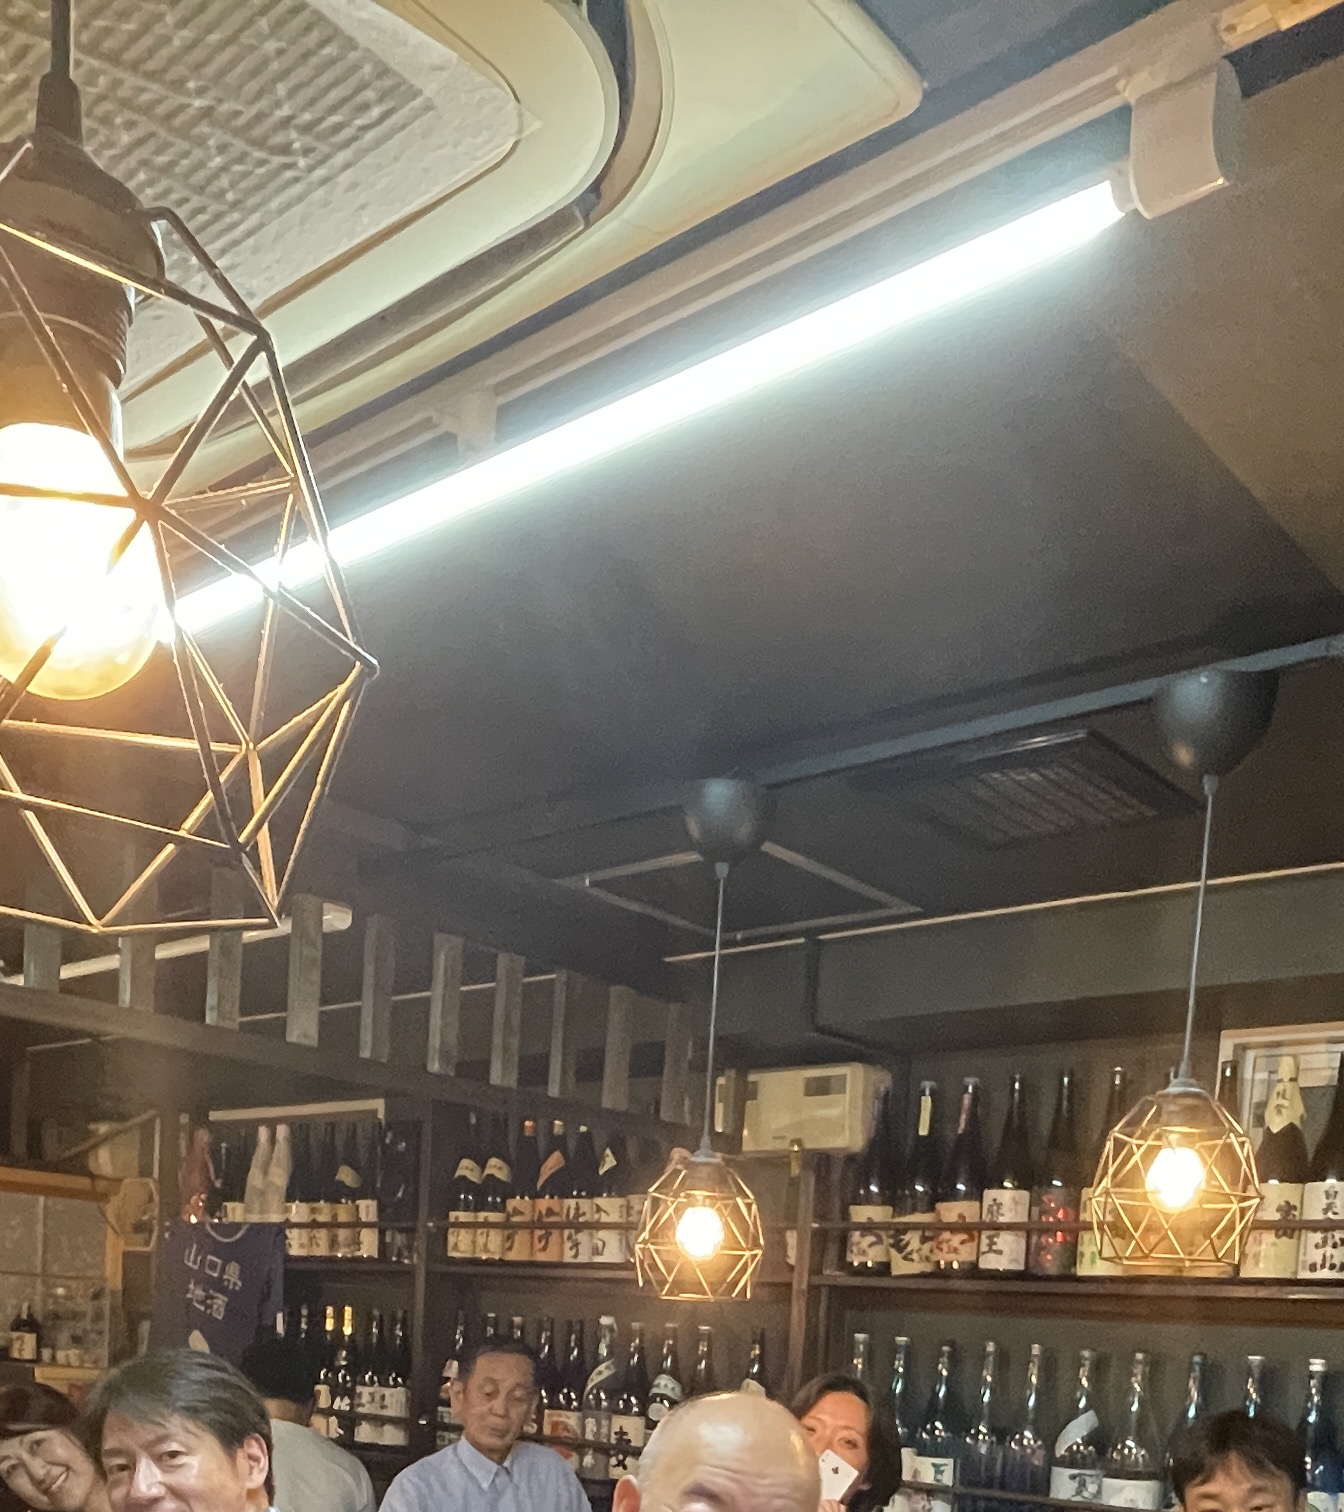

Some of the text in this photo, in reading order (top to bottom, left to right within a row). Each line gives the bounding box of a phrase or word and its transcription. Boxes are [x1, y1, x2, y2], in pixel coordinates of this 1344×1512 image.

[184, 1243, 243, 1291] 山口県
[186, 1279, 229, 1321] 地酒
